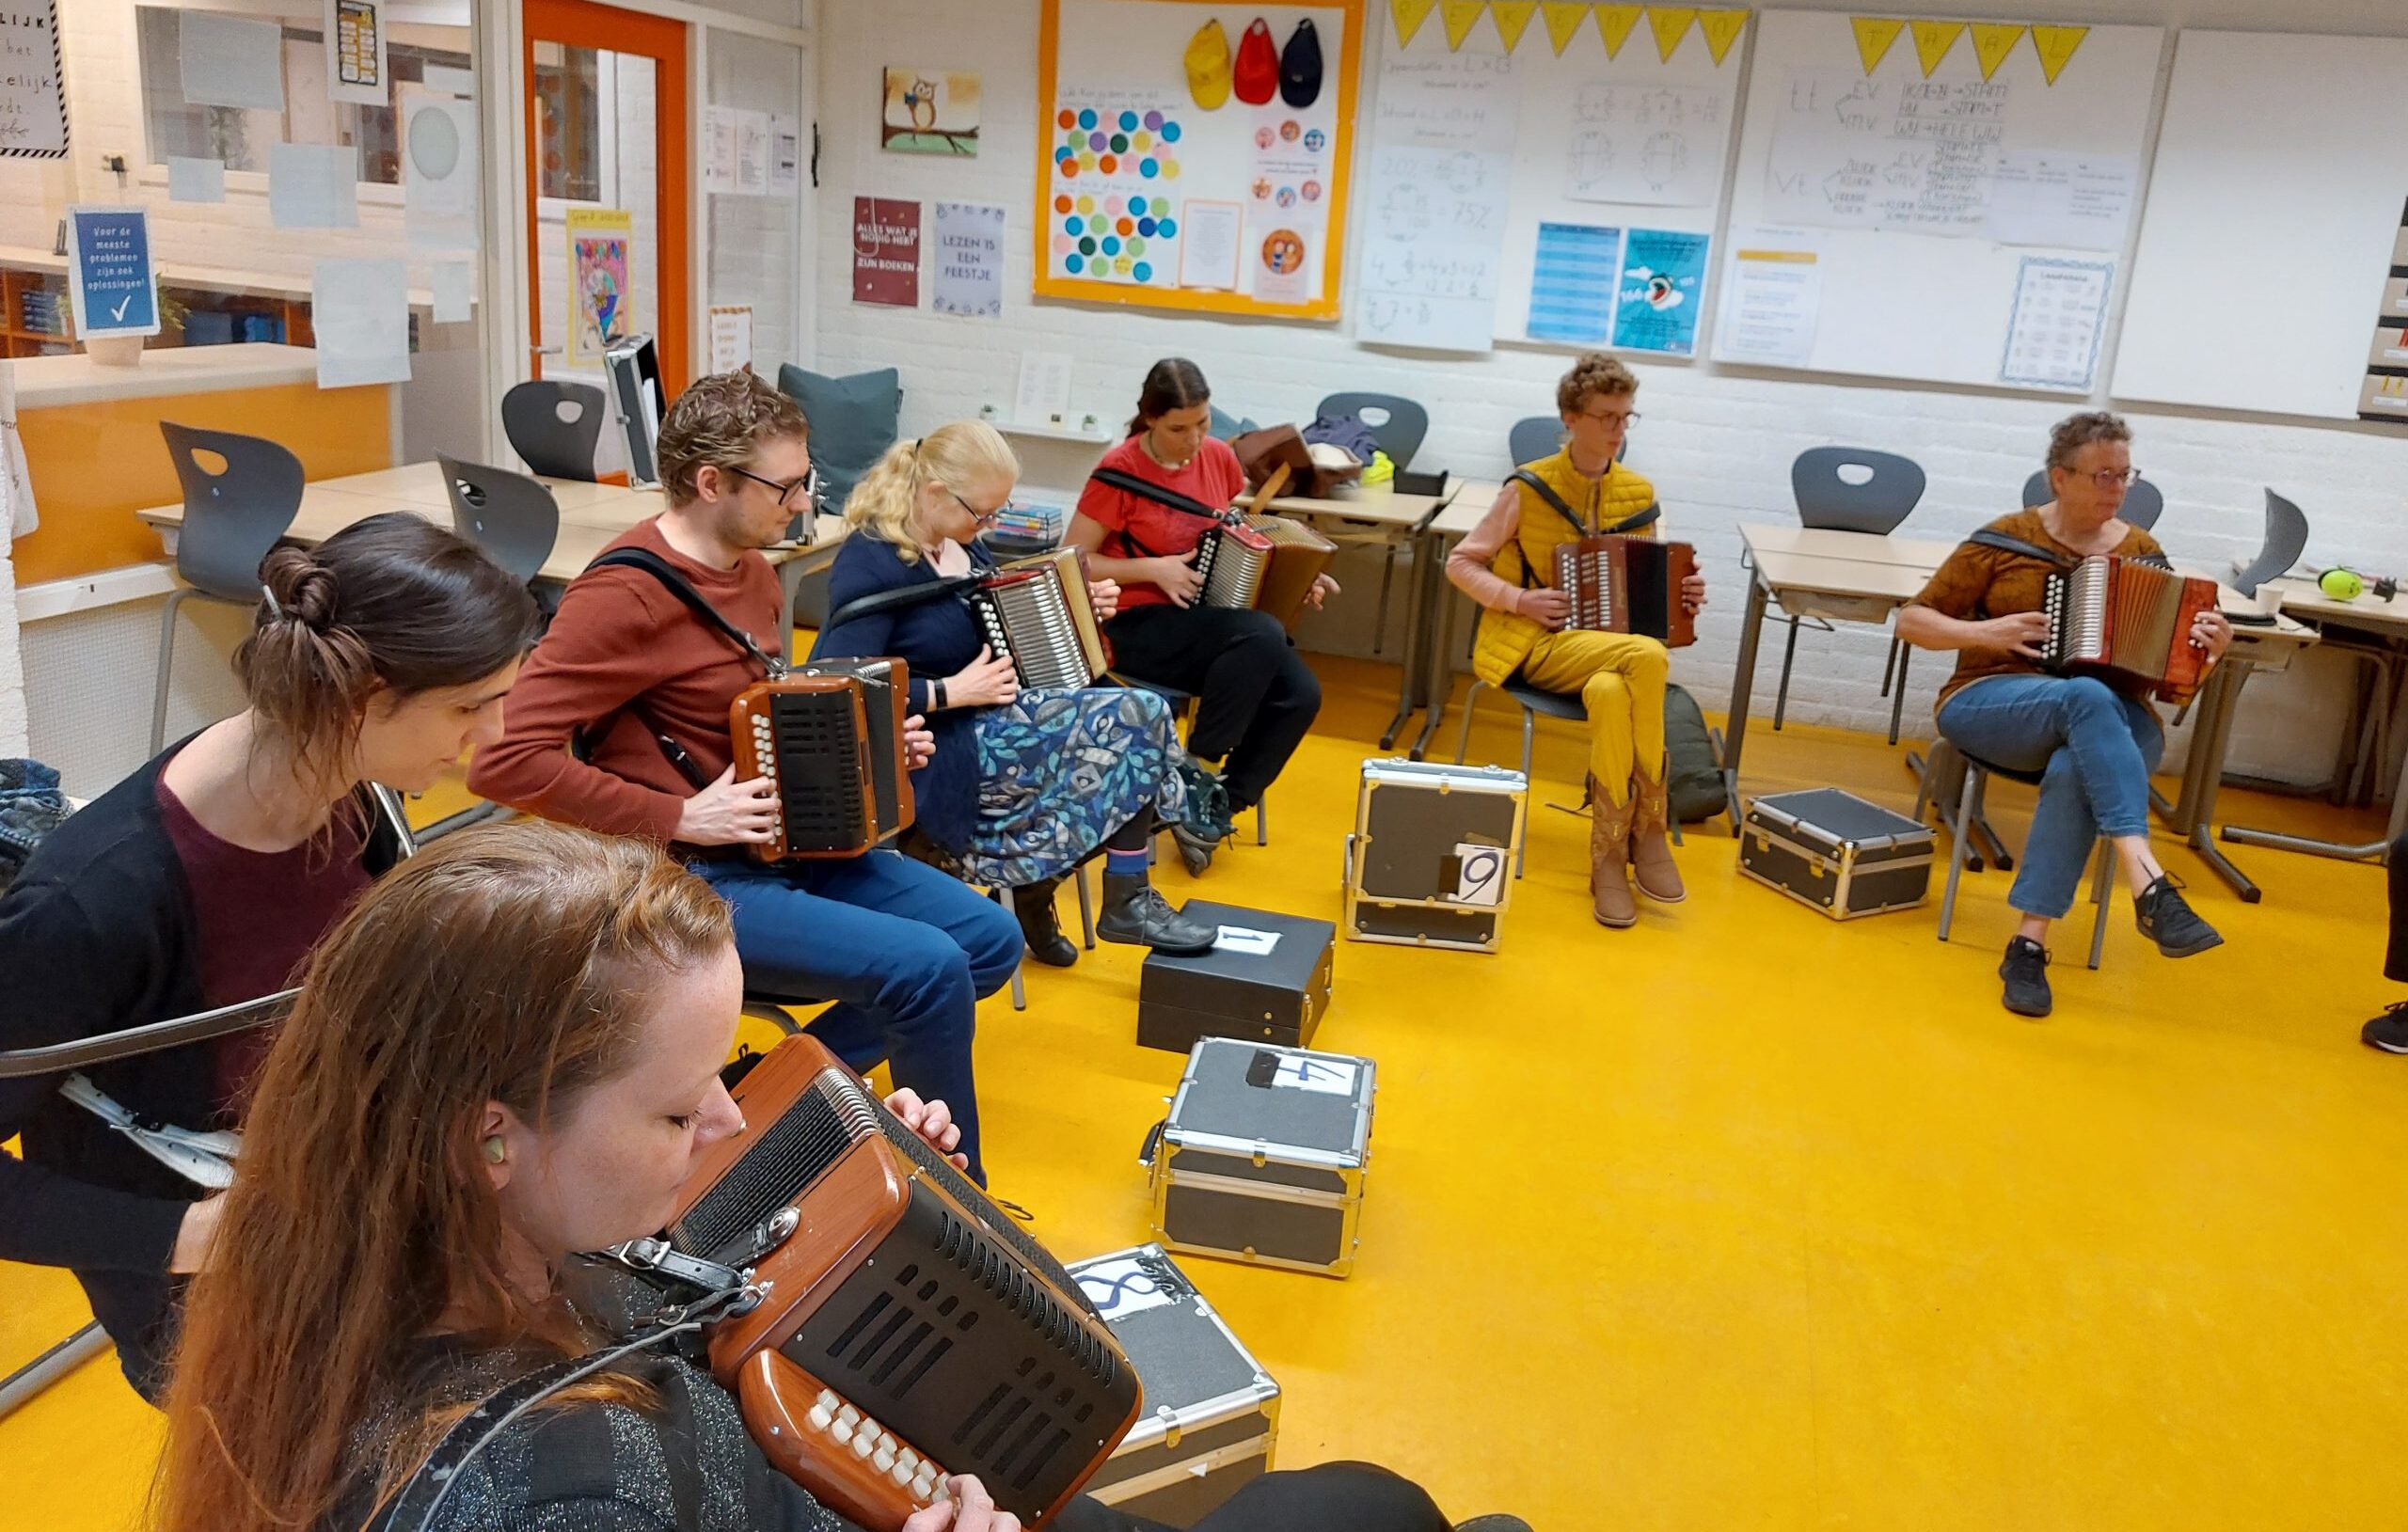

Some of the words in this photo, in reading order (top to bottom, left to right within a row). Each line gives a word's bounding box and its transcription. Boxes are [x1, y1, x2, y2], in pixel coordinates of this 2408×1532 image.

[0, 74, 52, 95] elijk
[94, 226, 118, 238] Voor
[119, 227, 132, 237] de
[943, 235, 981, 247] LEZEN
[89, 253, 138, 264] problemen
[958, 252, 980, 264] EEN
[944, 266, 992, 281] FEESTJE
[1278, 1060, 1348, 1082] 4
[1075, 1271, 1160, 1310] 8
